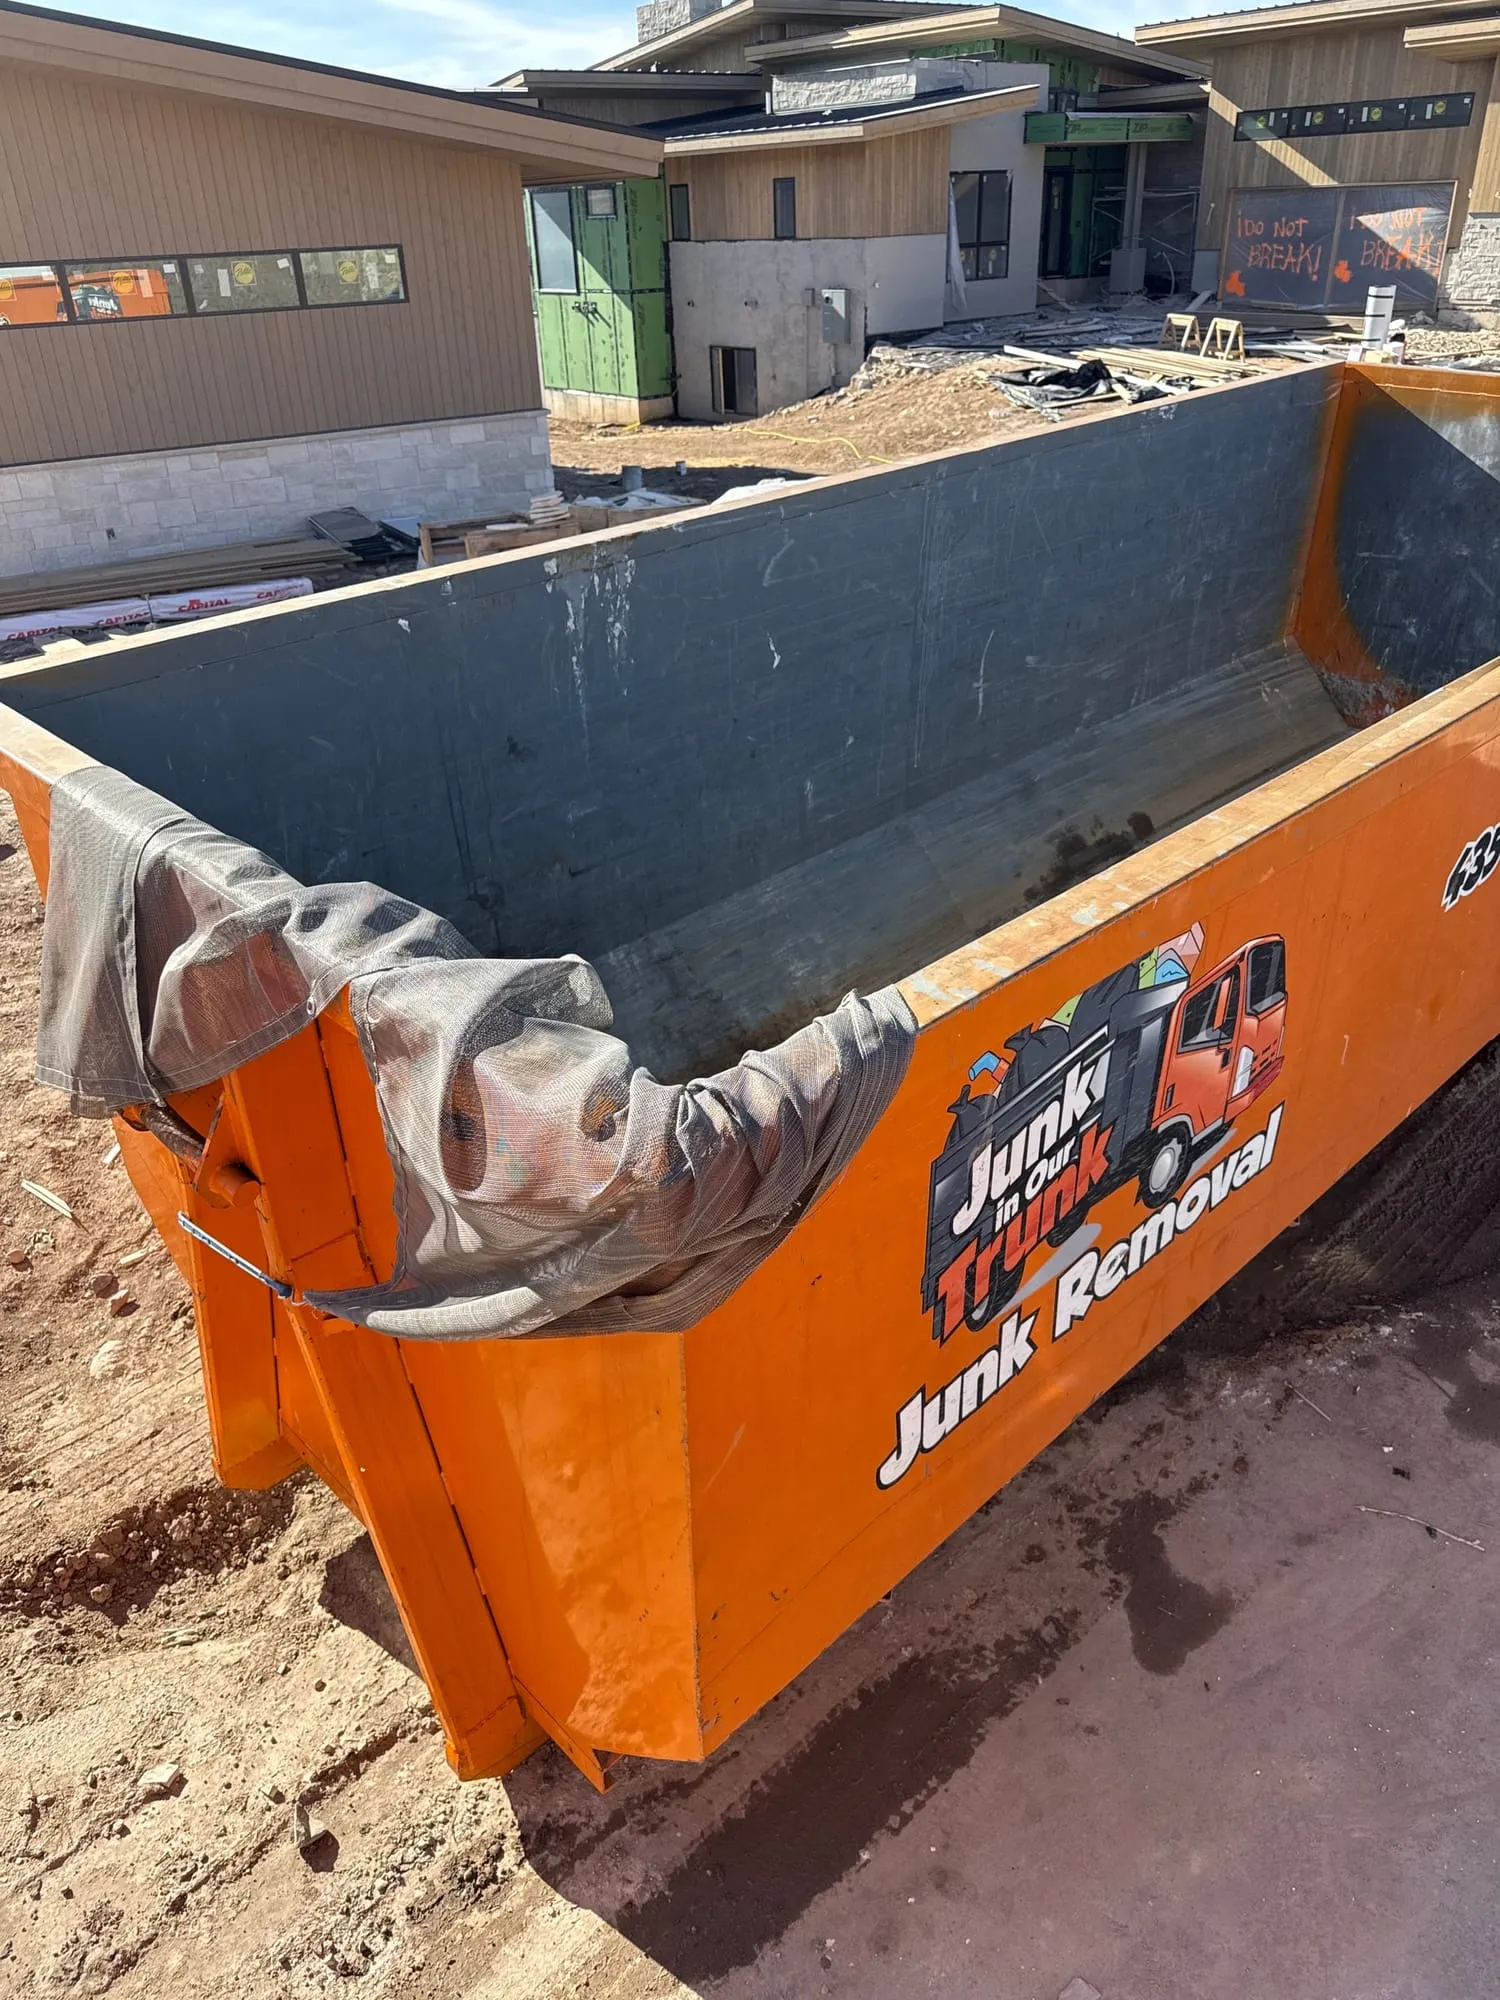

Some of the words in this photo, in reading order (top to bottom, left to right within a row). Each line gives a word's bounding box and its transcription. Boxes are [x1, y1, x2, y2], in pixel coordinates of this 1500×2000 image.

[1273, 216, 1308, 237] NOT
[1247, 242, 1322, 281] BREAK!
[177, 598, 231, 613] CAPITAL
[952, 1061, 1093, 1236] Junk
[937, 1122, 1114, 1340] Trunk
[994, 1192, 1021, 1233] in
[878, 1309, 1037, 1488] Junk
[1053, 1102, 1283, 1341] Removal
